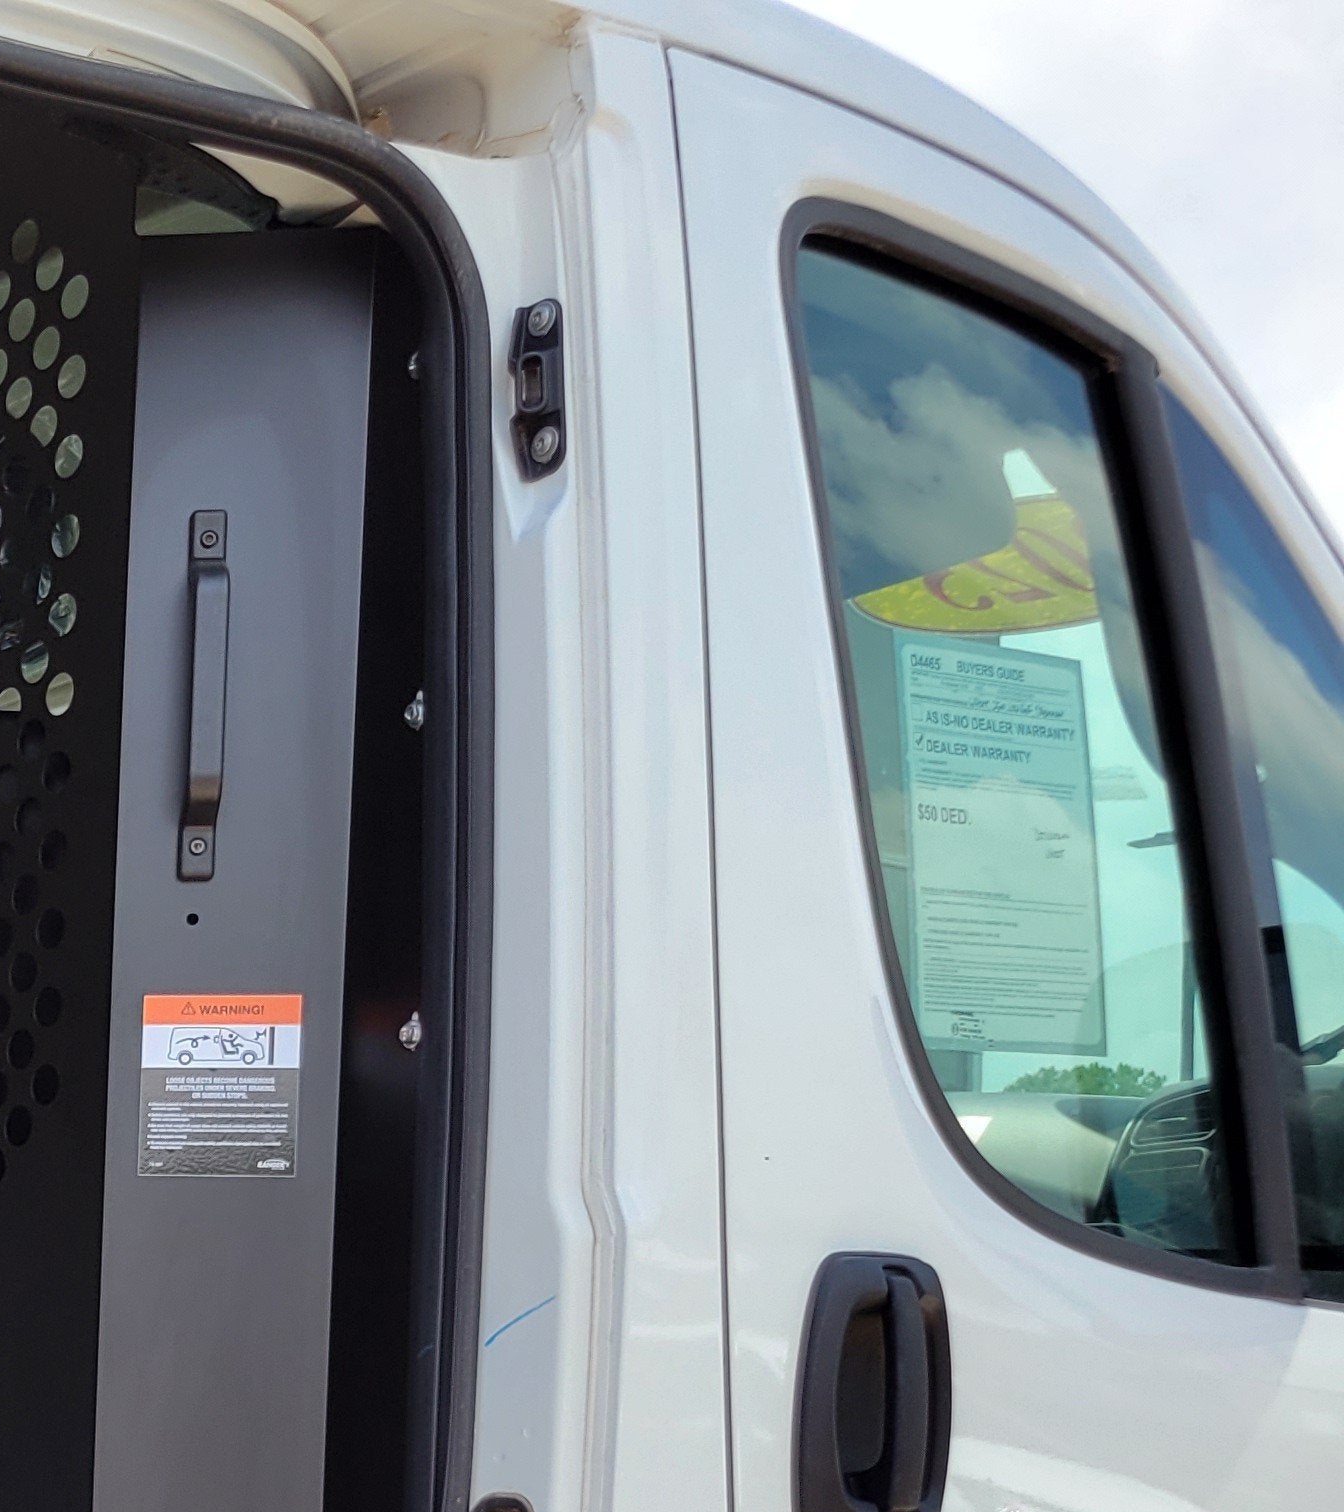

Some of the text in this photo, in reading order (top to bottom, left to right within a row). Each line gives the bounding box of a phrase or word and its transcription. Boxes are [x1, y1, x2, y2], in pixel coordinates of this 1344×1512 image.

[956, 660, 994, 678] BUYERS
[996, 666, 1026, 682] GUIDE
[925, 710, 939, 725] AS
[971, 717, 1013, 736] DEALER
[1015, 723, 1076, 743] WARRANTY
[926, 739, 1031, 764] DEALER WARRANTY
[916, 802, 972, 826] $50 DED.
[199, 1005, 265, 1016] WARNING!
